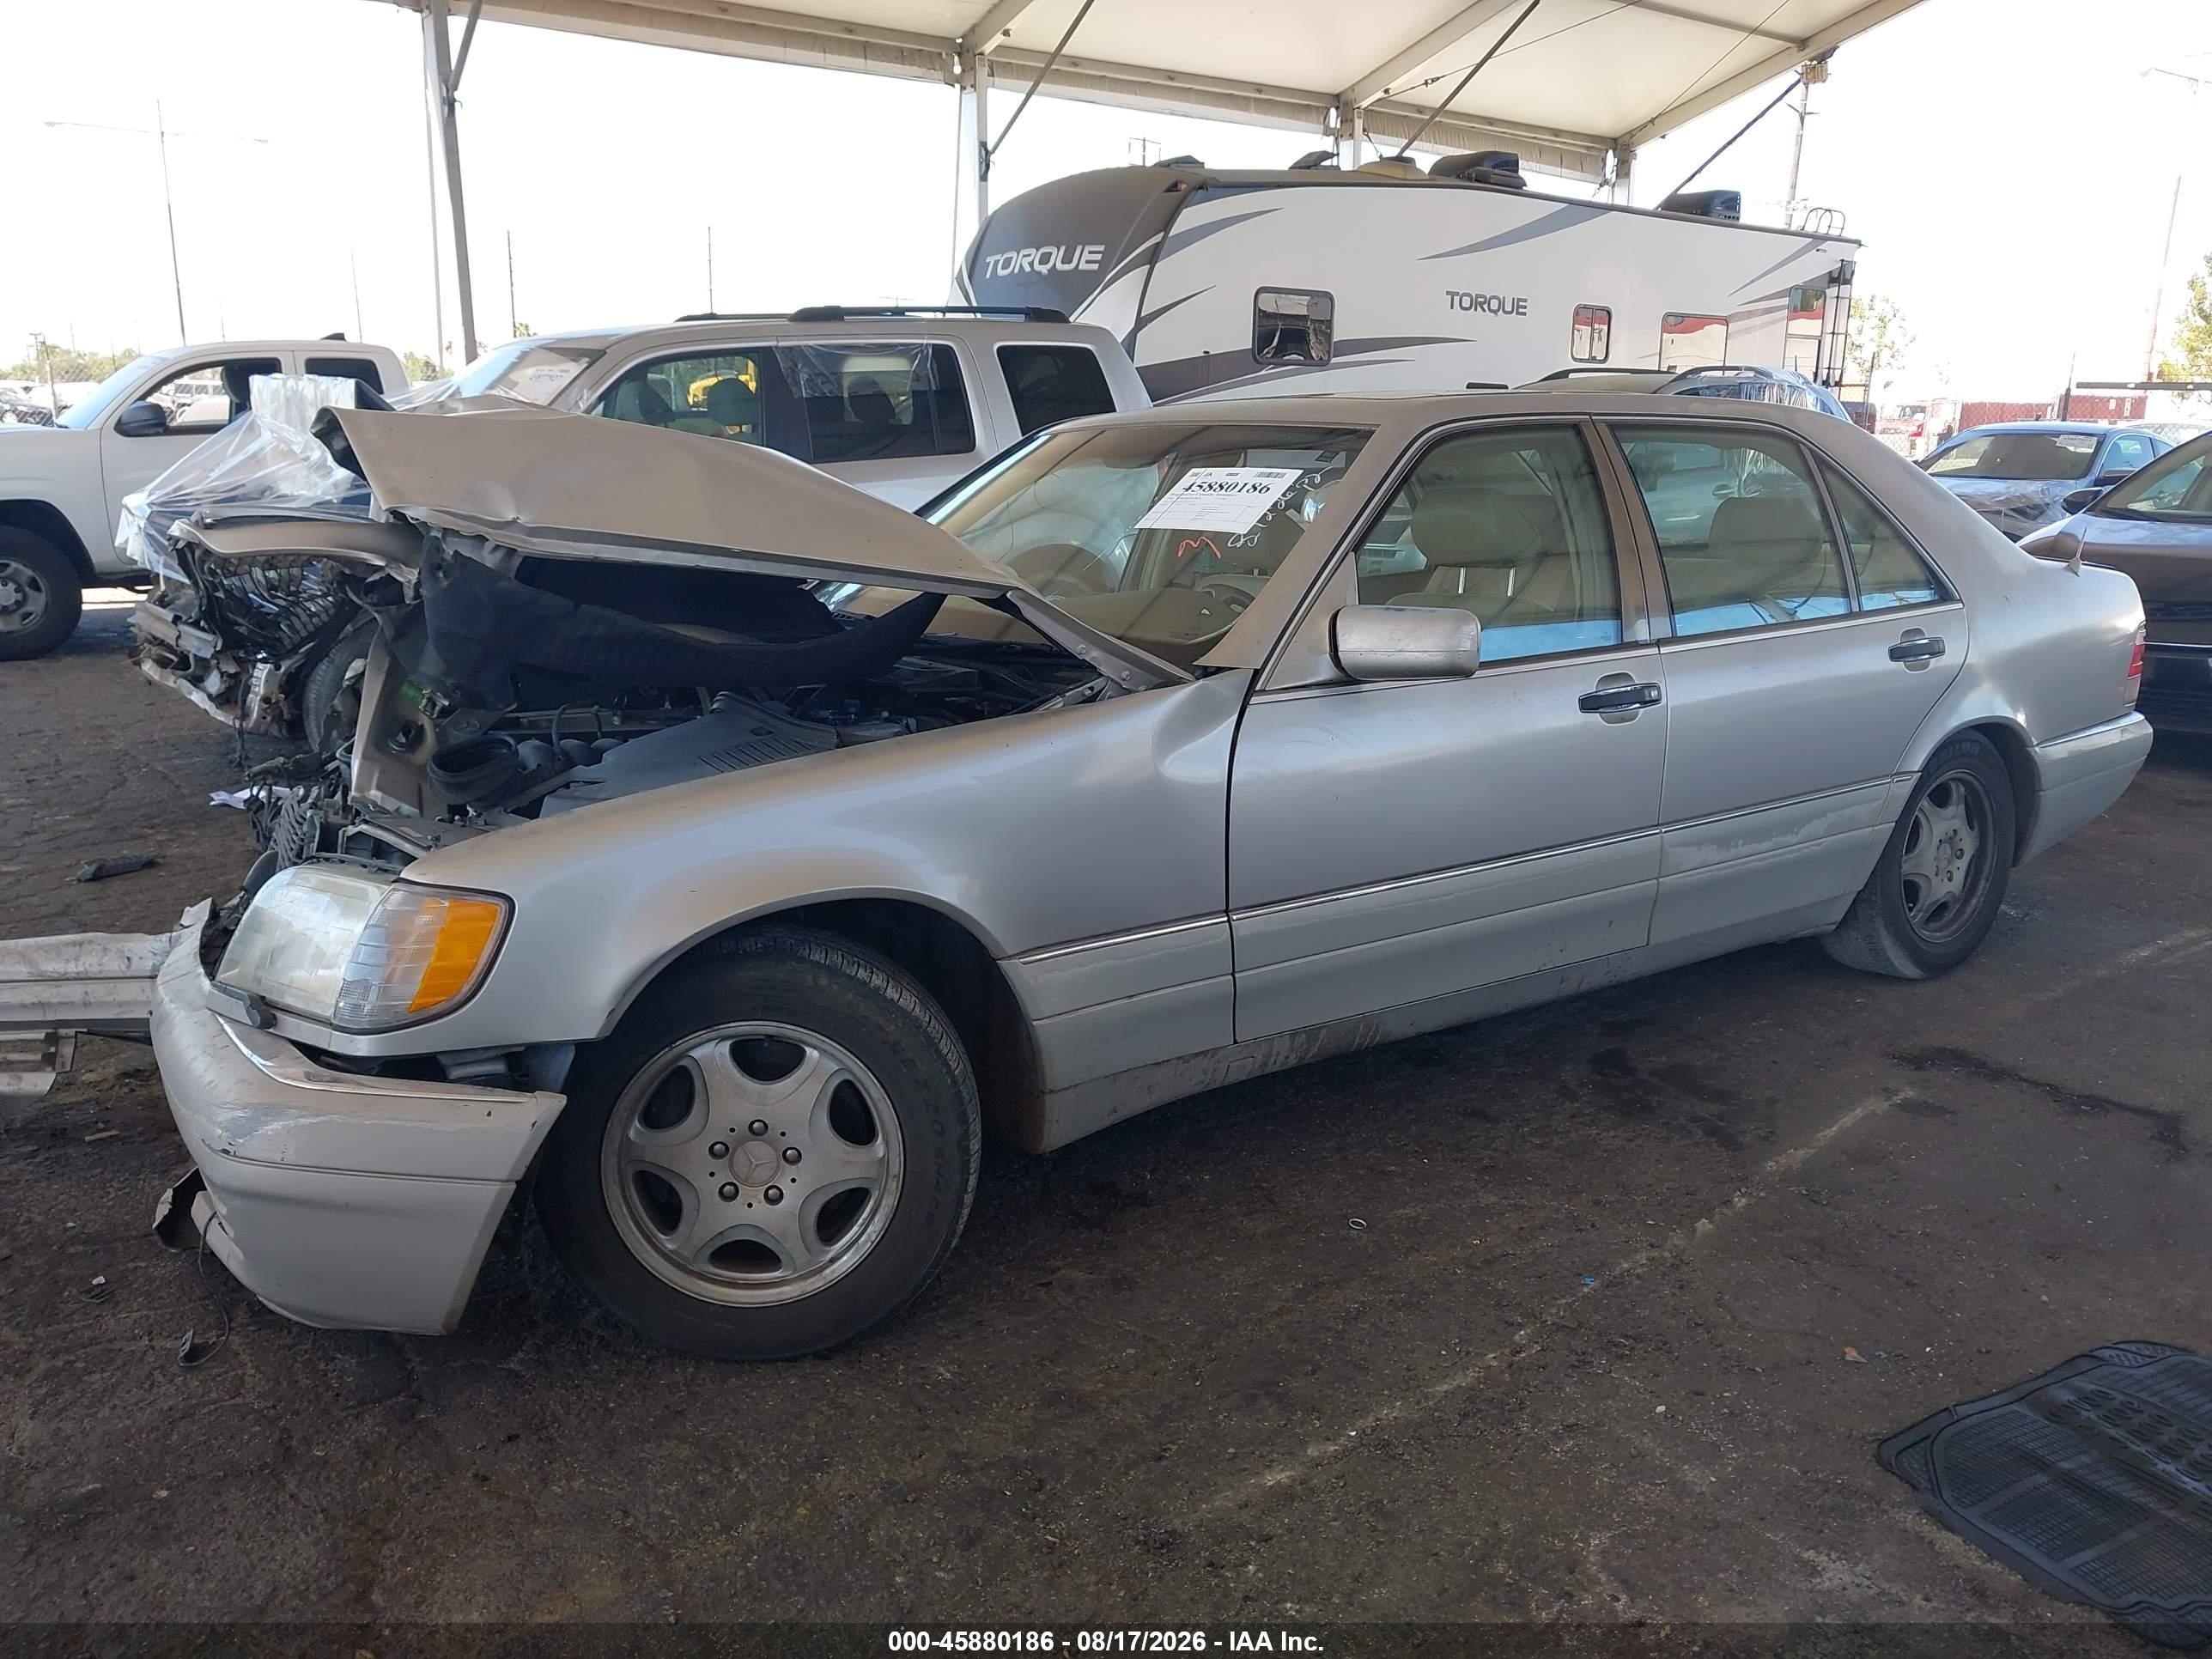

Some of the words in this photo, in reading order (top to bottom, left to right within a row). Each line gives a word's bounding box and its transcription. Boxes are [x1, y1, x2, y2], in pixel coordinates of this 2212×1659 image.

[986, 245, 1105, 278] TORQUE
[1445, 290, 1528, 317] TORQUE
[1182, 481, 1274, 495] 45880186
